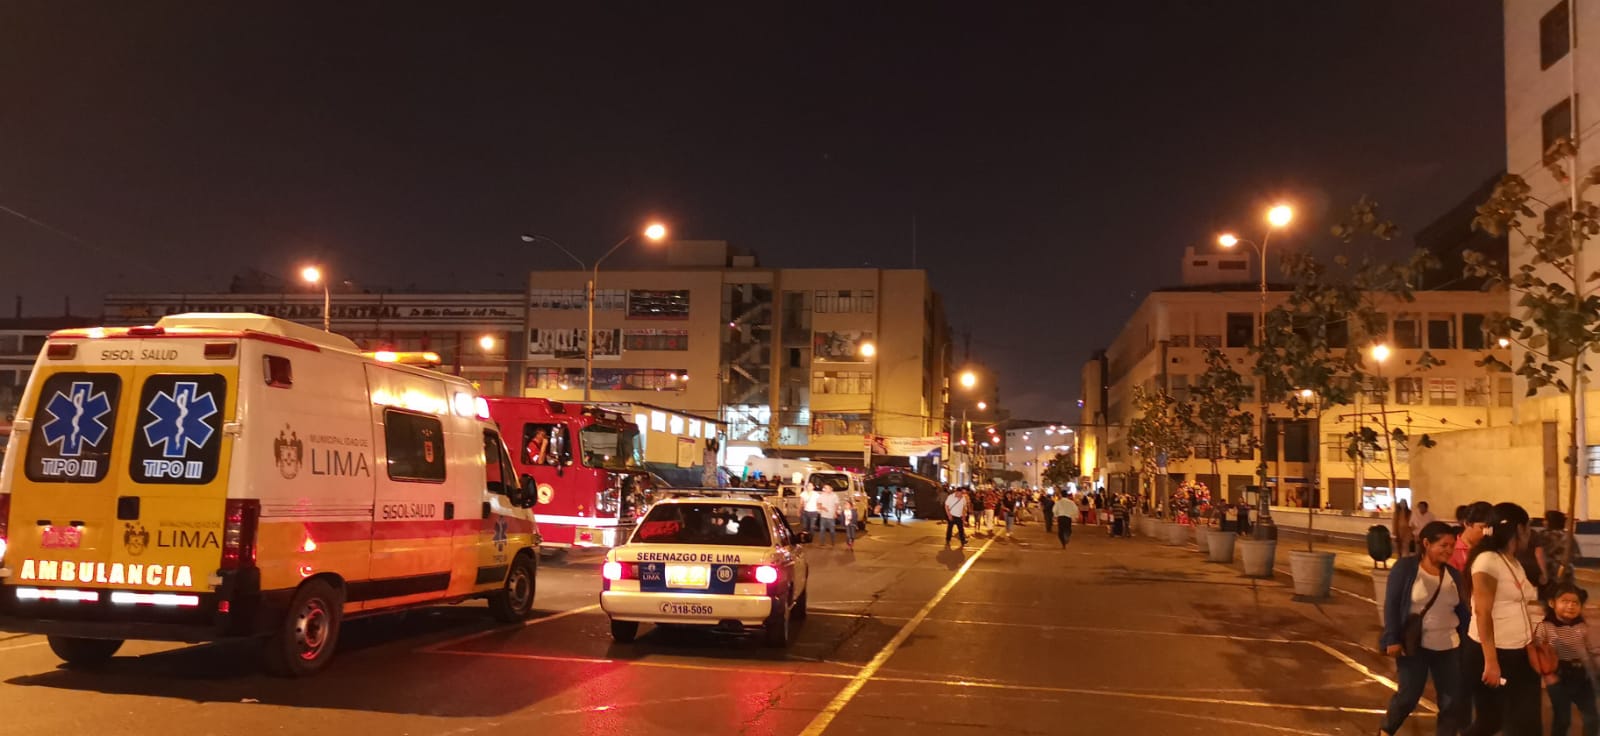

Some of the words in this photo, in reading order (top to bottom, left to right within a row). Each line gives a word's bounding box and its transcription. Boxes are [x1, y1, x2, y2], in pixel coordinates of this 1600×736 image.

[101, 349, 134, 361] SISOL
[140, 348, 178, 361] SALUD
[41, 457, 80, 477] TIPO
[80, 459, 97, 477] III
[143, 459, 184, 478] TIPO
[185, 461, 203, 479] III
[311, 448, 370, 478] LIMA
[382, 503, 409, 519] SISOL
[410, 503, 436, 518] SALUD
[157, 529, 220, 550] LIMA
[636, 551, 697, 562] SERENAZGO
[700, 552, 713, 563] DE
[716, 553, 741, 563] LIMA
[20, 559, 193, 587] AMBULANCIA
[642, 573, 661, 581] LIMA
[671, 604, 713, 614] 318-5050
